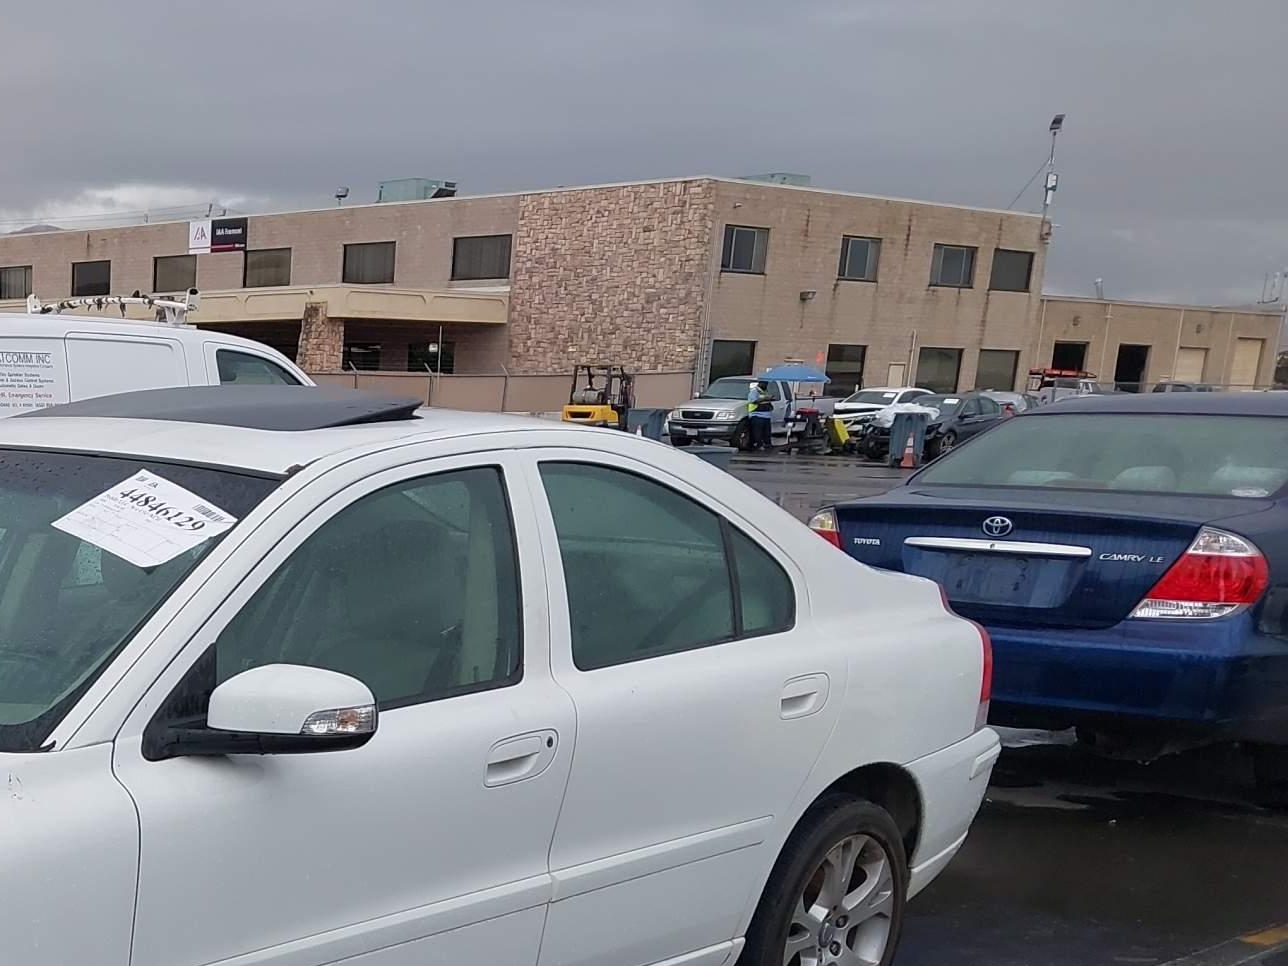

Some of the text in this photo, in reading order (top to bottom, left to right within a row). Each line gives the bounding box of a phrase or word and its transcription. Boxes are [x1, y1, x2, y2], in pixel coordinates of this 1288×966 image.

[35, 353, 52, 364] INC
[8, 392, 34, 400] Emergency
[119, 488, 206, 532] 44846129
[854, 537, 881, 546] TOYOTA
[1099, 553, 1146, 562] CAMRY
